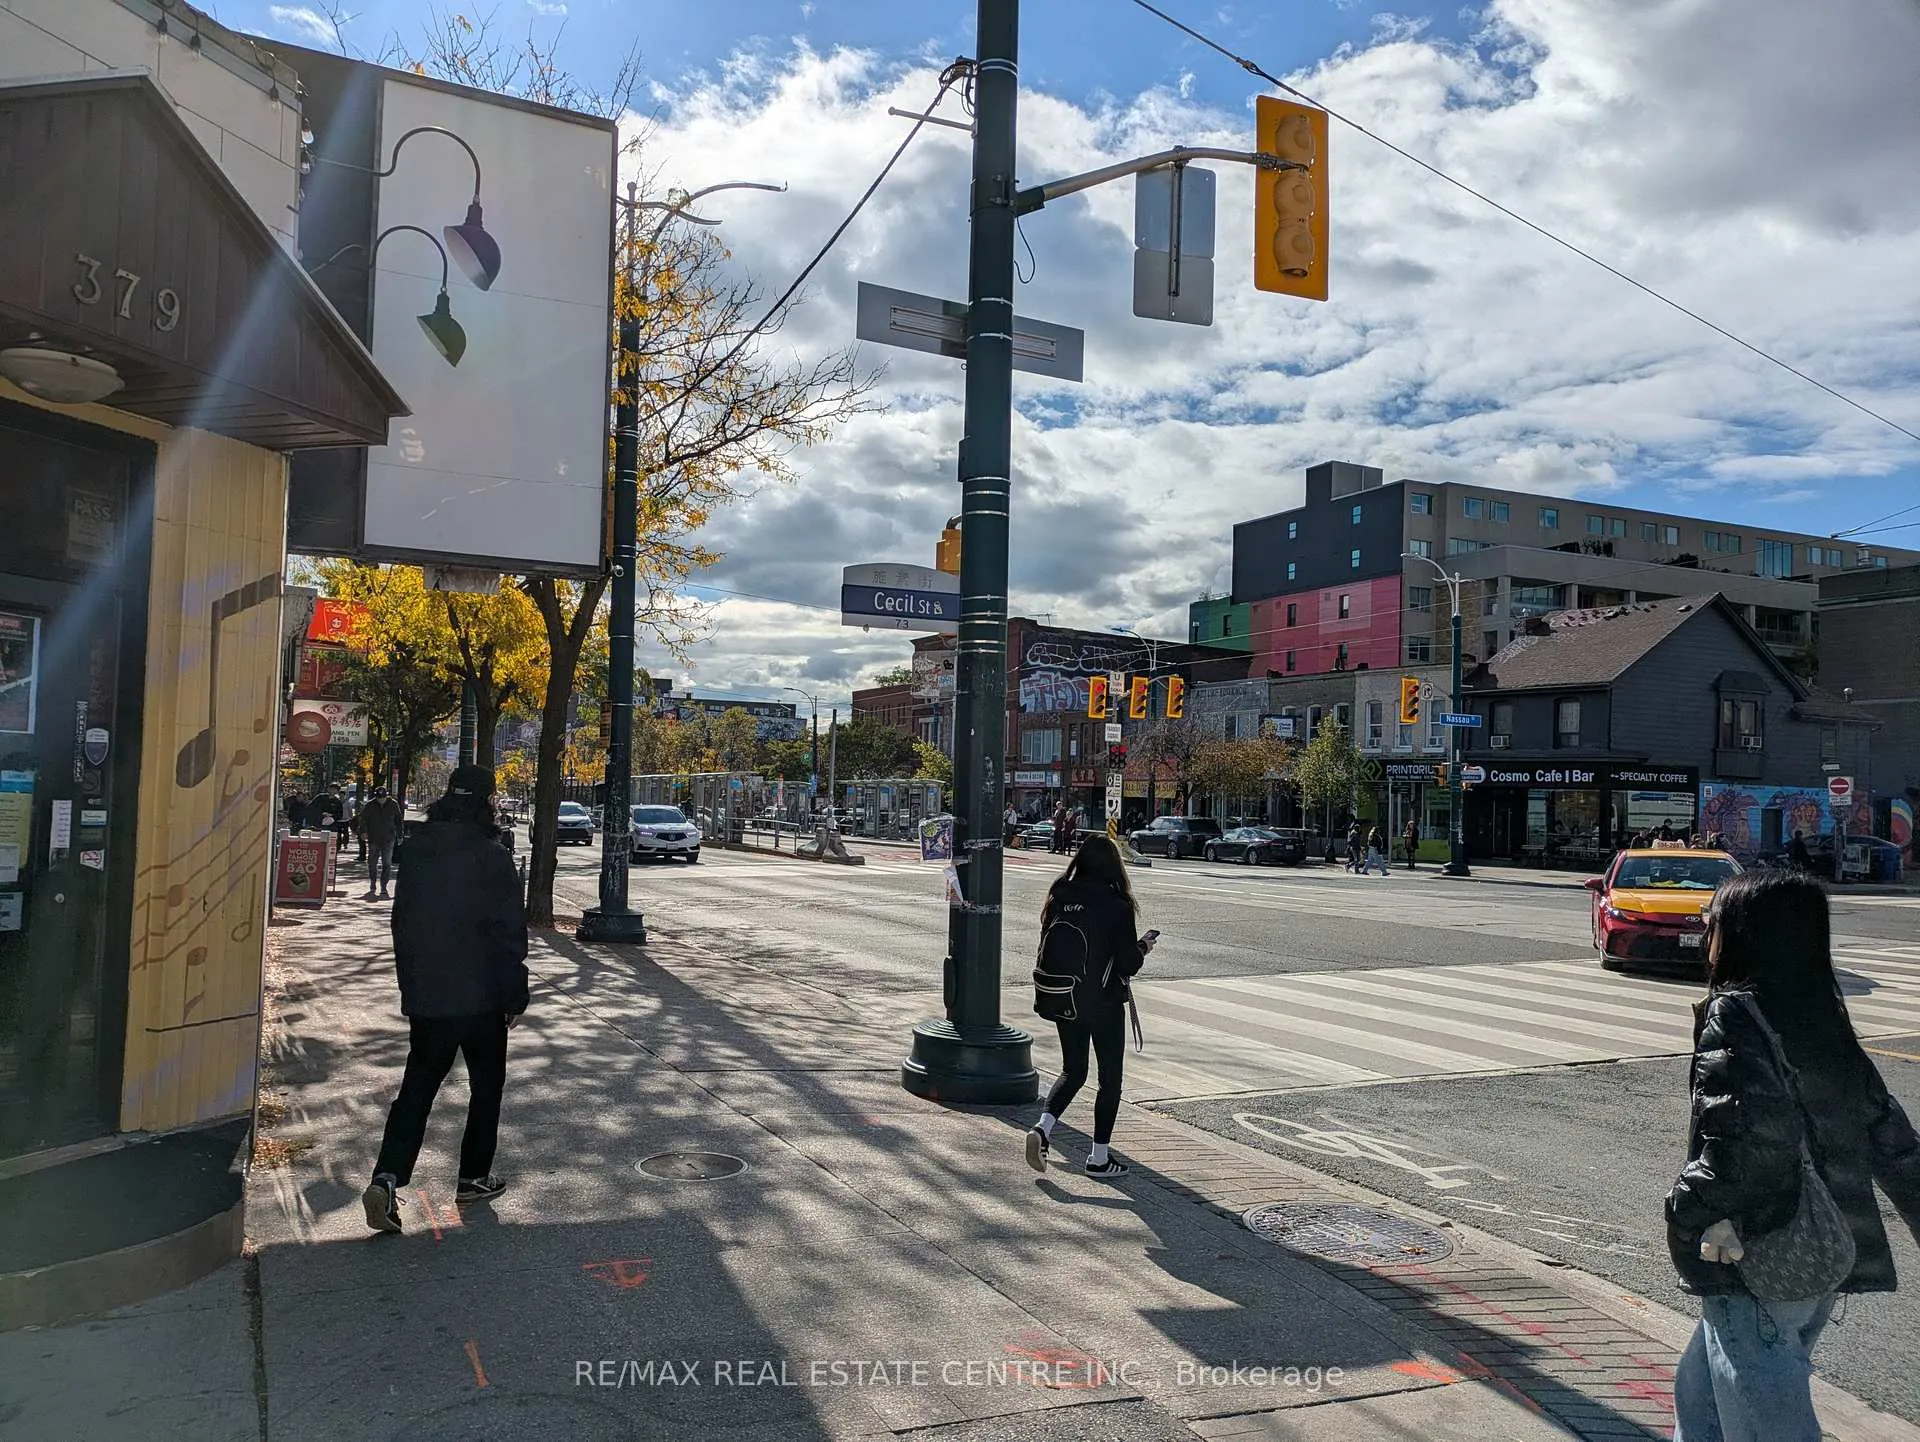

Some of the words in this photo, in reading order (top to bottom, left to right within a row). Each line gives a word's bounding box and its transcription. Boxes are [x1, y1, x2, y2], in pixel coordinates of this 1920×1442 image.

[72, 252, 181, 333] 379
[874, 591, 914, 613] Cecil
[918, 599, 931, 614] St
[896, 619, 909, 628] 73
[1446, 715, 1470, 724] Nassau
[1490, 769, 1530, 782] Cosmo
[1535, 769, 1562, 782] Cafe
[1572, 769, 1594, 782] Bar
[1619, 771, 1658, 782] SPECIALTY
[1659, 773, 1688, 783] COFFEE
[287, 863, 317, 873] BAO
